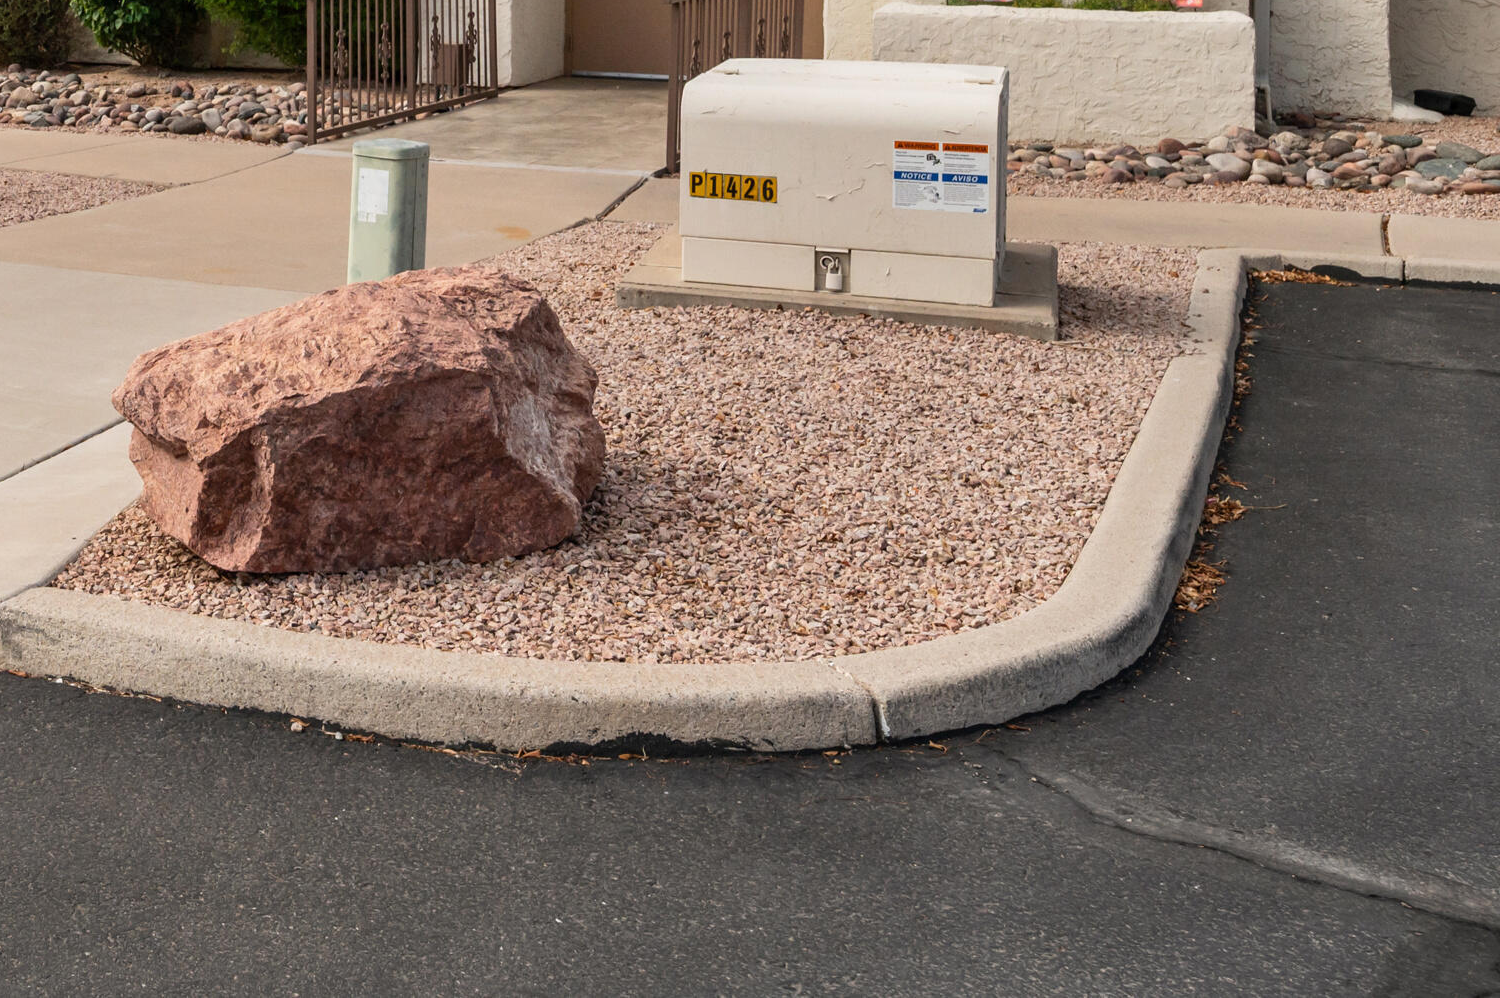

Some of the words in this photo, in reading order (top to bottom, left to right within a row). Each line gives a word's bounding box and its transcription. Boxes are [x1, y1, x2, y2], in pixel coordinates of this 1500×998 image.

[900, 172, 933, 180] NOTICE
[952, 175, 979, 183] AVISO
[691, 173, 775, 202] P1426
